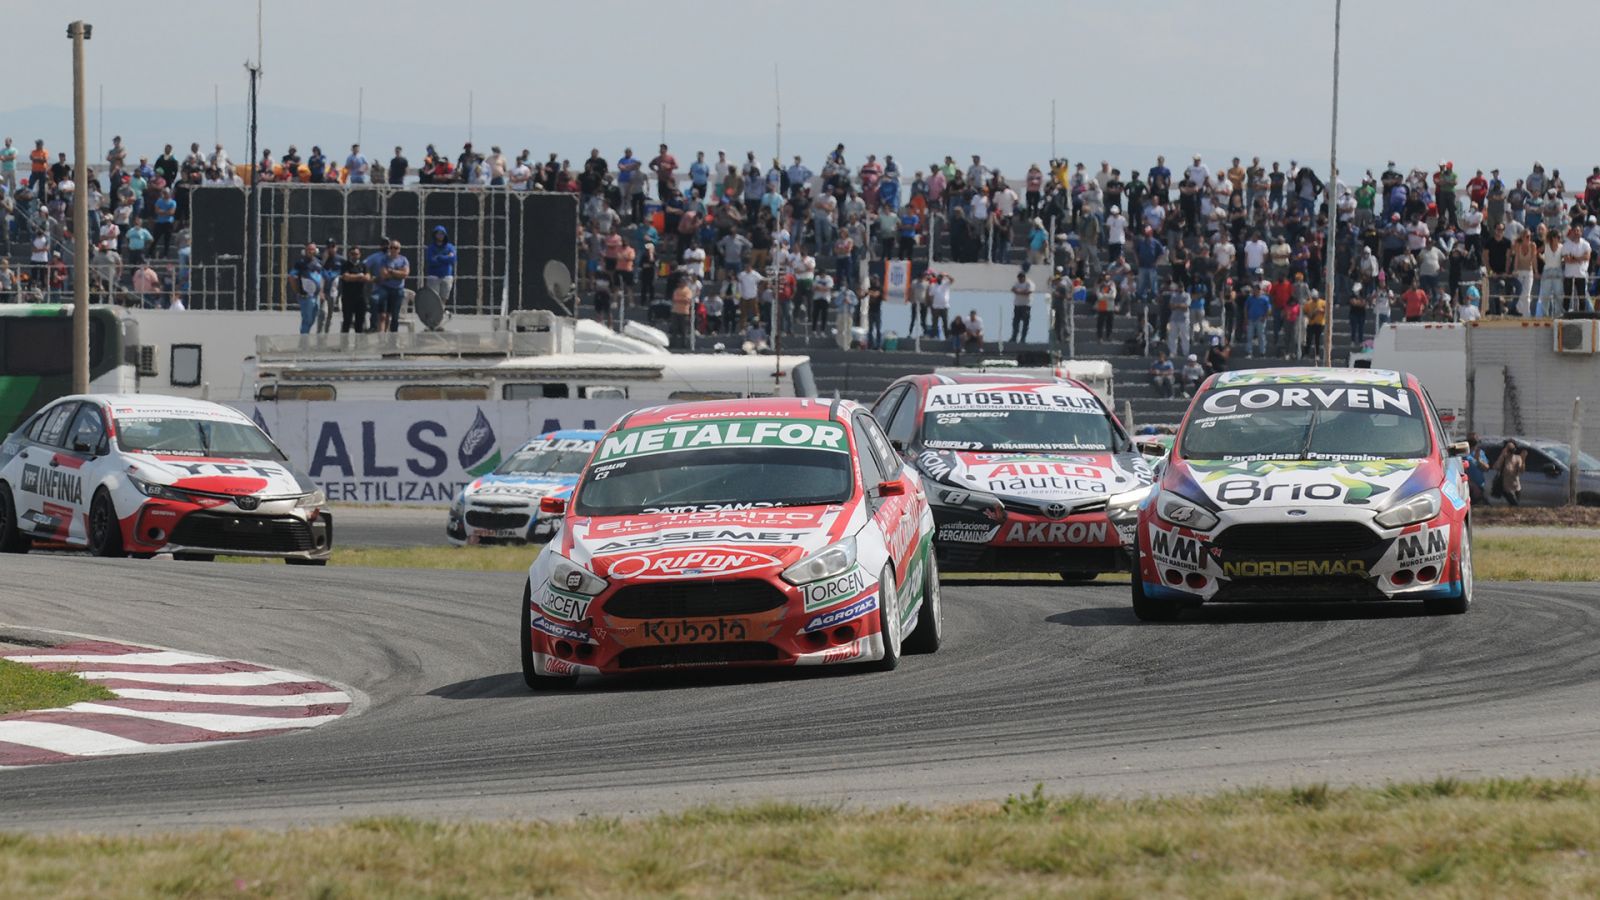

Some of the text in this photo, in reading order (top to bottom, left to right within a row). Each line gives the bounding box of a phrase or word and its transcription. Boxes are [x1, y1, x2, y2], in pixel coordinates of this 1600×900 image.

[930, 392, 1099, 410] AUTOS DEL SUR
[1203, 388, 1412, 416] CORVEN
[690, 411, 790, 419] CRUCIANELLI
[936, 411, 1010, 419] DOMENECH
[308, 420, 448, 478] ALS
[600, 422, 844, 459] METALFOR
[1223, 452, 1386, 462] Parabrisas Pergamino
[165, 462, 284, 478] YPF
[595, 471, 610, 480] C3
[988, 463, 1103, 479] Auto
[39, 467, 82, 505] INFINIA
[315, 481, 470, 501] ERTILIZANT
[989, 477, 1106, 493] náutica
[662, 510, 814, 521] TORITO
[596, 530, 812, 551] ARSEMET
[1006, 522, 1107, 543] AKRON
[1223, 560, 1370, 579] NORDEMAQ
[800, 569, 864, 604] TORCEN
[542, 590, 588, 620] ORCEN
[807, 599, 874, 629] AGROTAX
[536, 619, 588, 639] AGROTAX
[644, 618, 747, 643] Kubota
